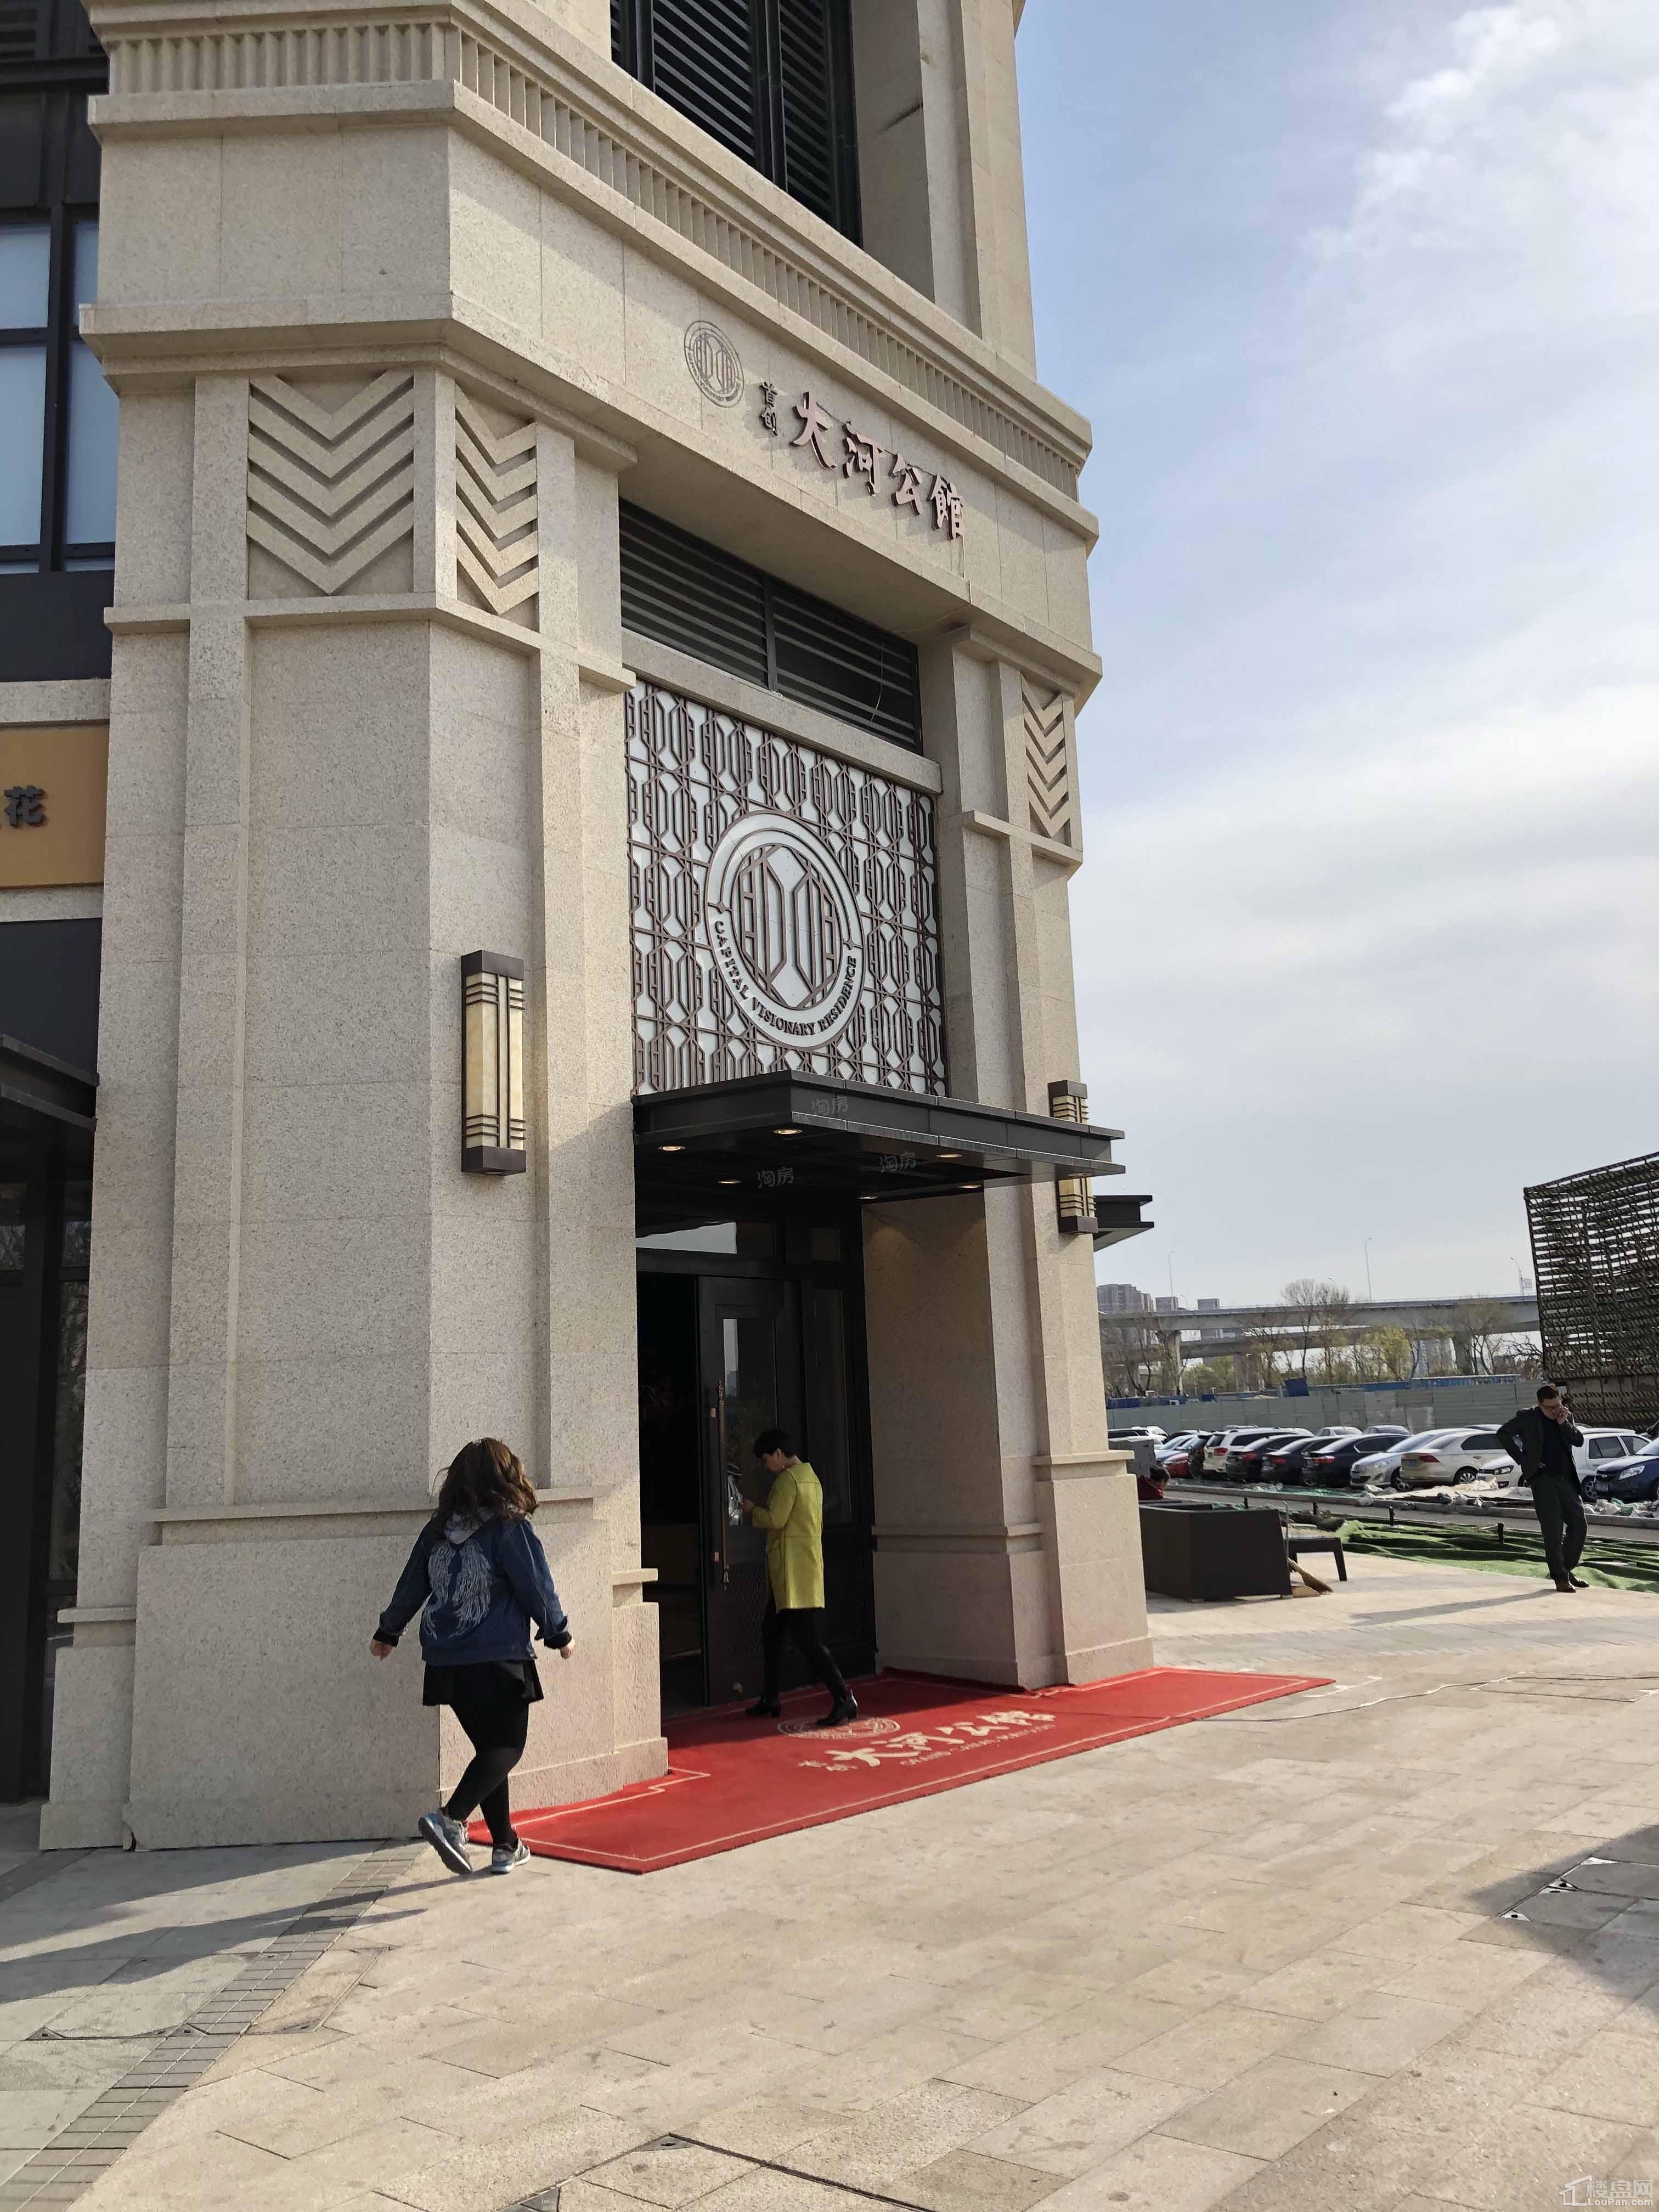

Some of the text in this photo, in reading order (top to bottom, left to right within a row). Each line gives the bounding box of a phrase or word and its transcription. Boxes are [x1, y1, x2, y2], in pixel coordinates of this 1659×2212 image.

[4, 786, 44, 827] 花
[715, 921, 856, 1035] CAPITAL VISIONARY RESIDENCE
